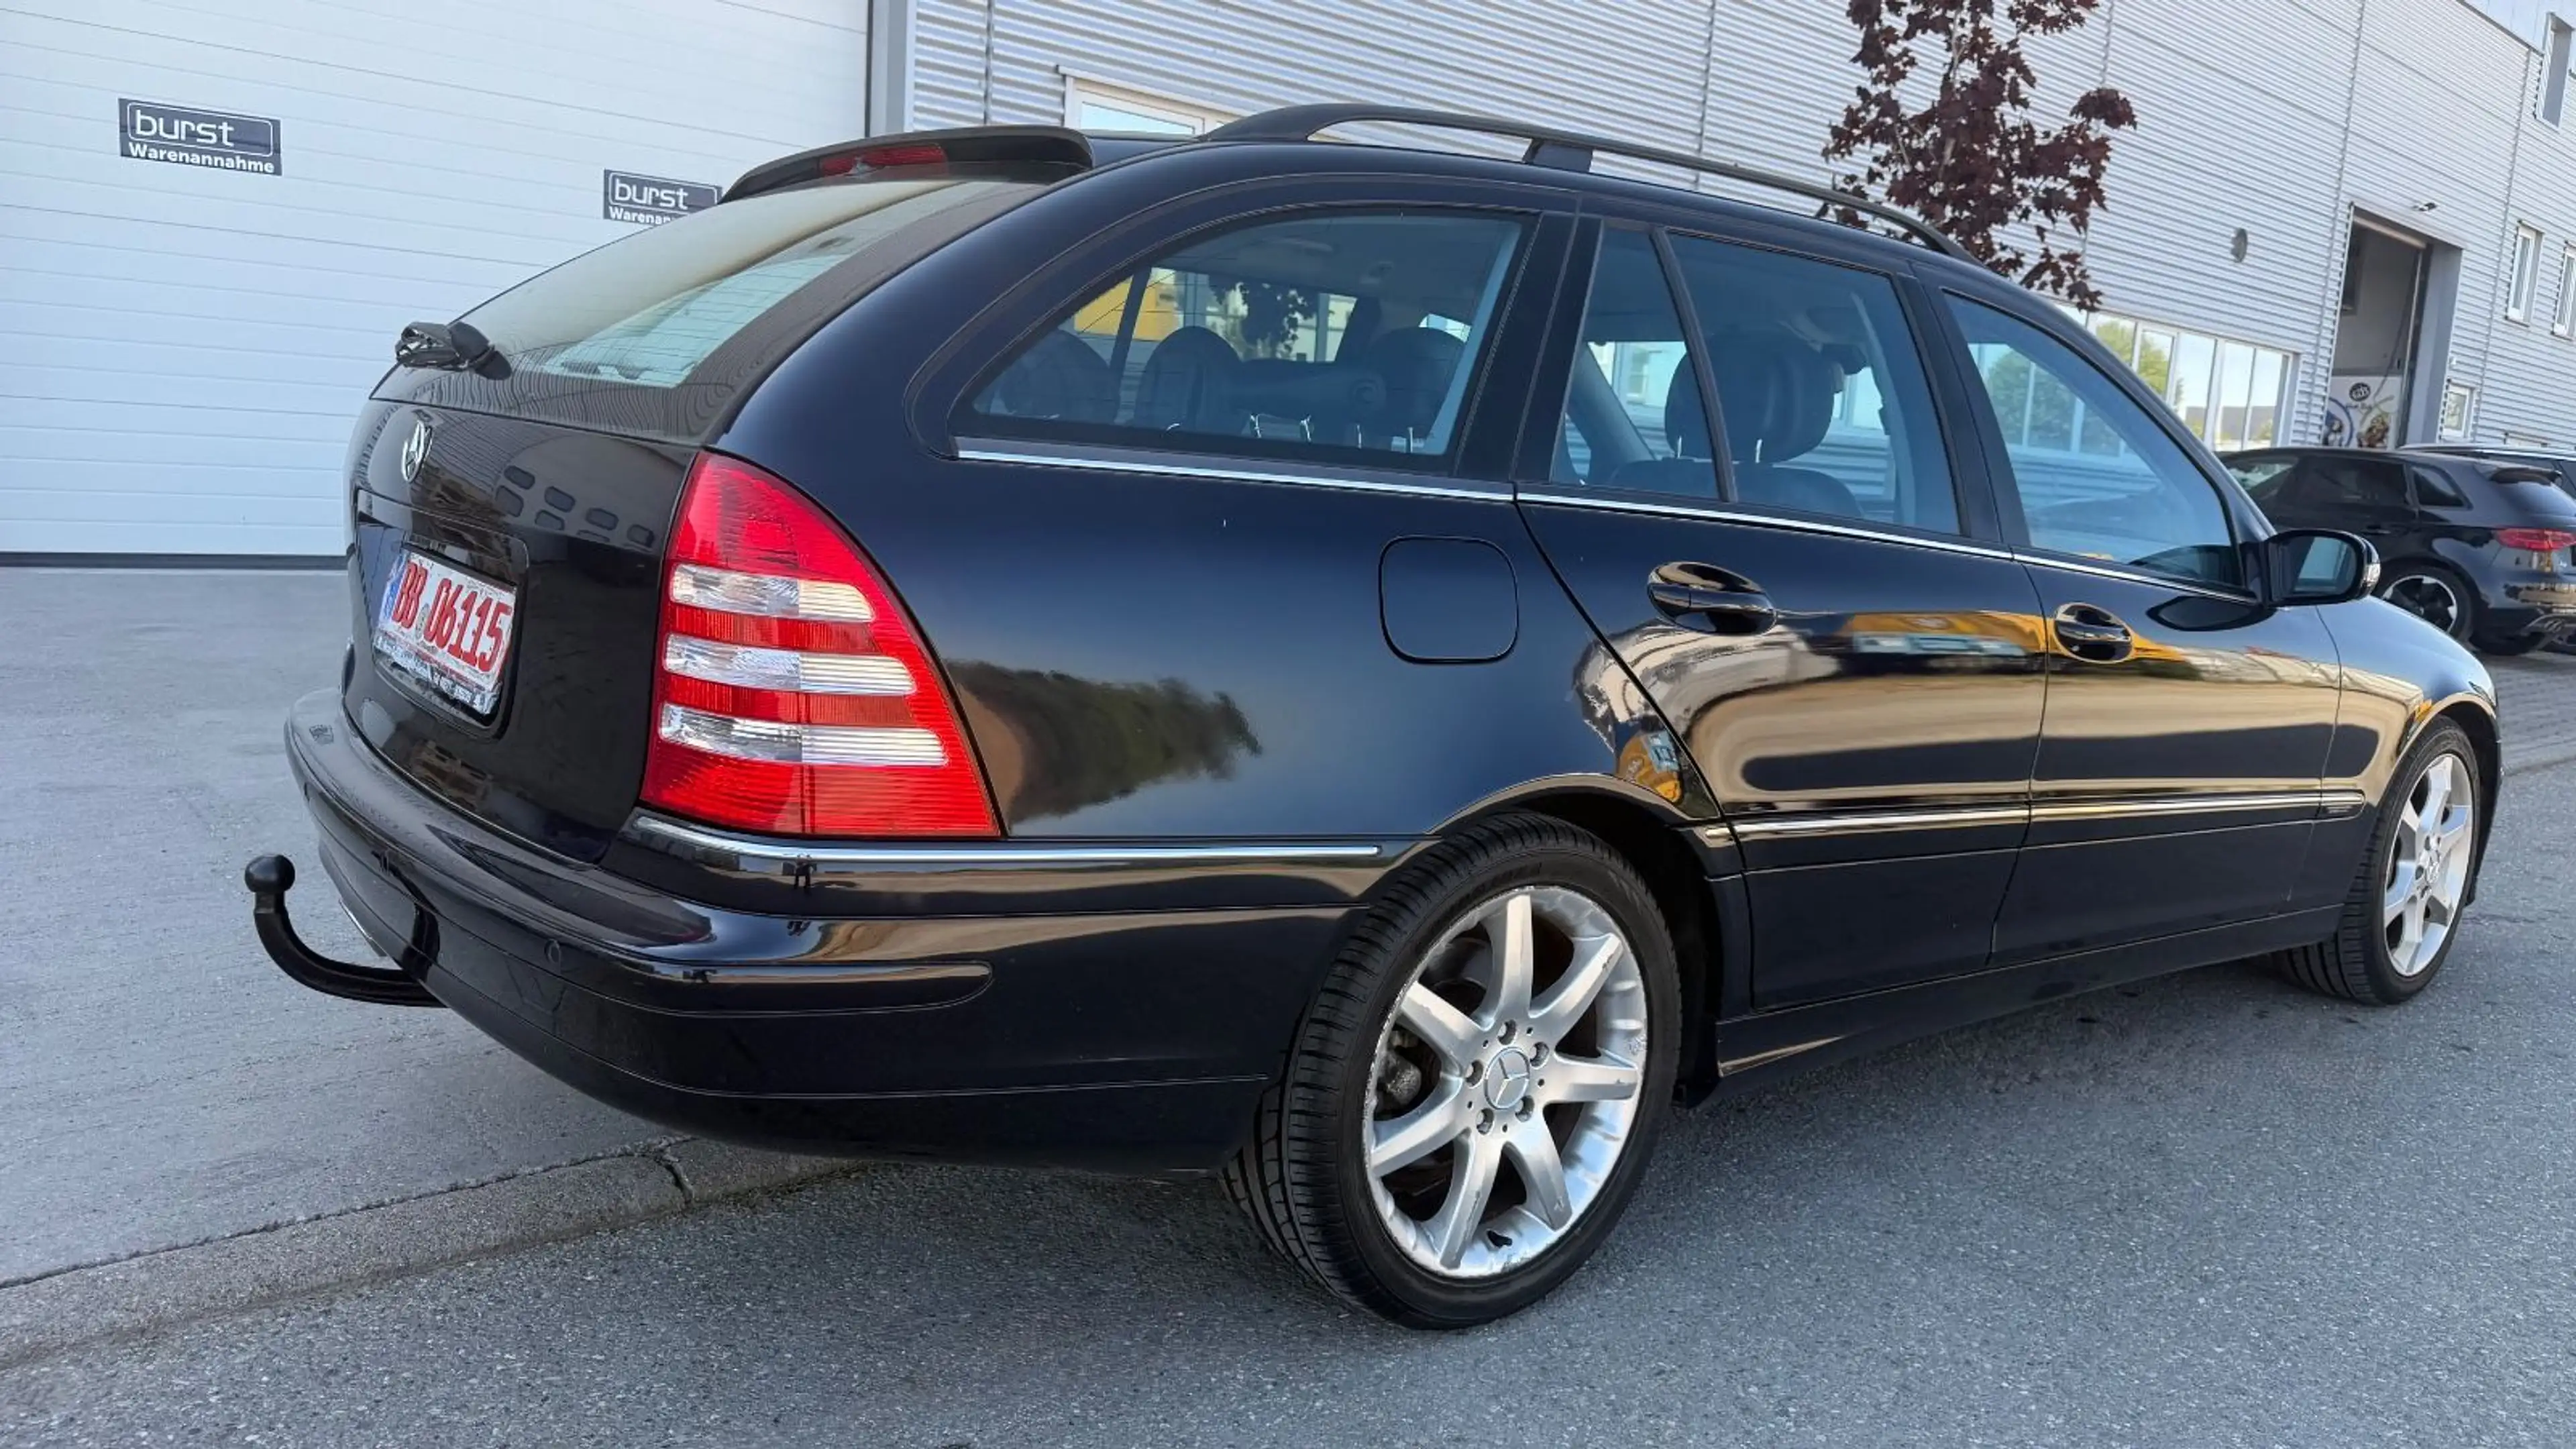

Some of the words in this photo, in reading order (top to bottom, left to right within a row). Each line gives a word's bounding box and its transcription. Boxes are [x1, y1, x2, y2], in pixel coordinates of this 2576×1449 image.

[136, 109, 234, 147] burst
[129, 142, 274, 174] Warenannahme
[614, 178, 688, 210] burst
[424, 578, 513, 672] 06115
